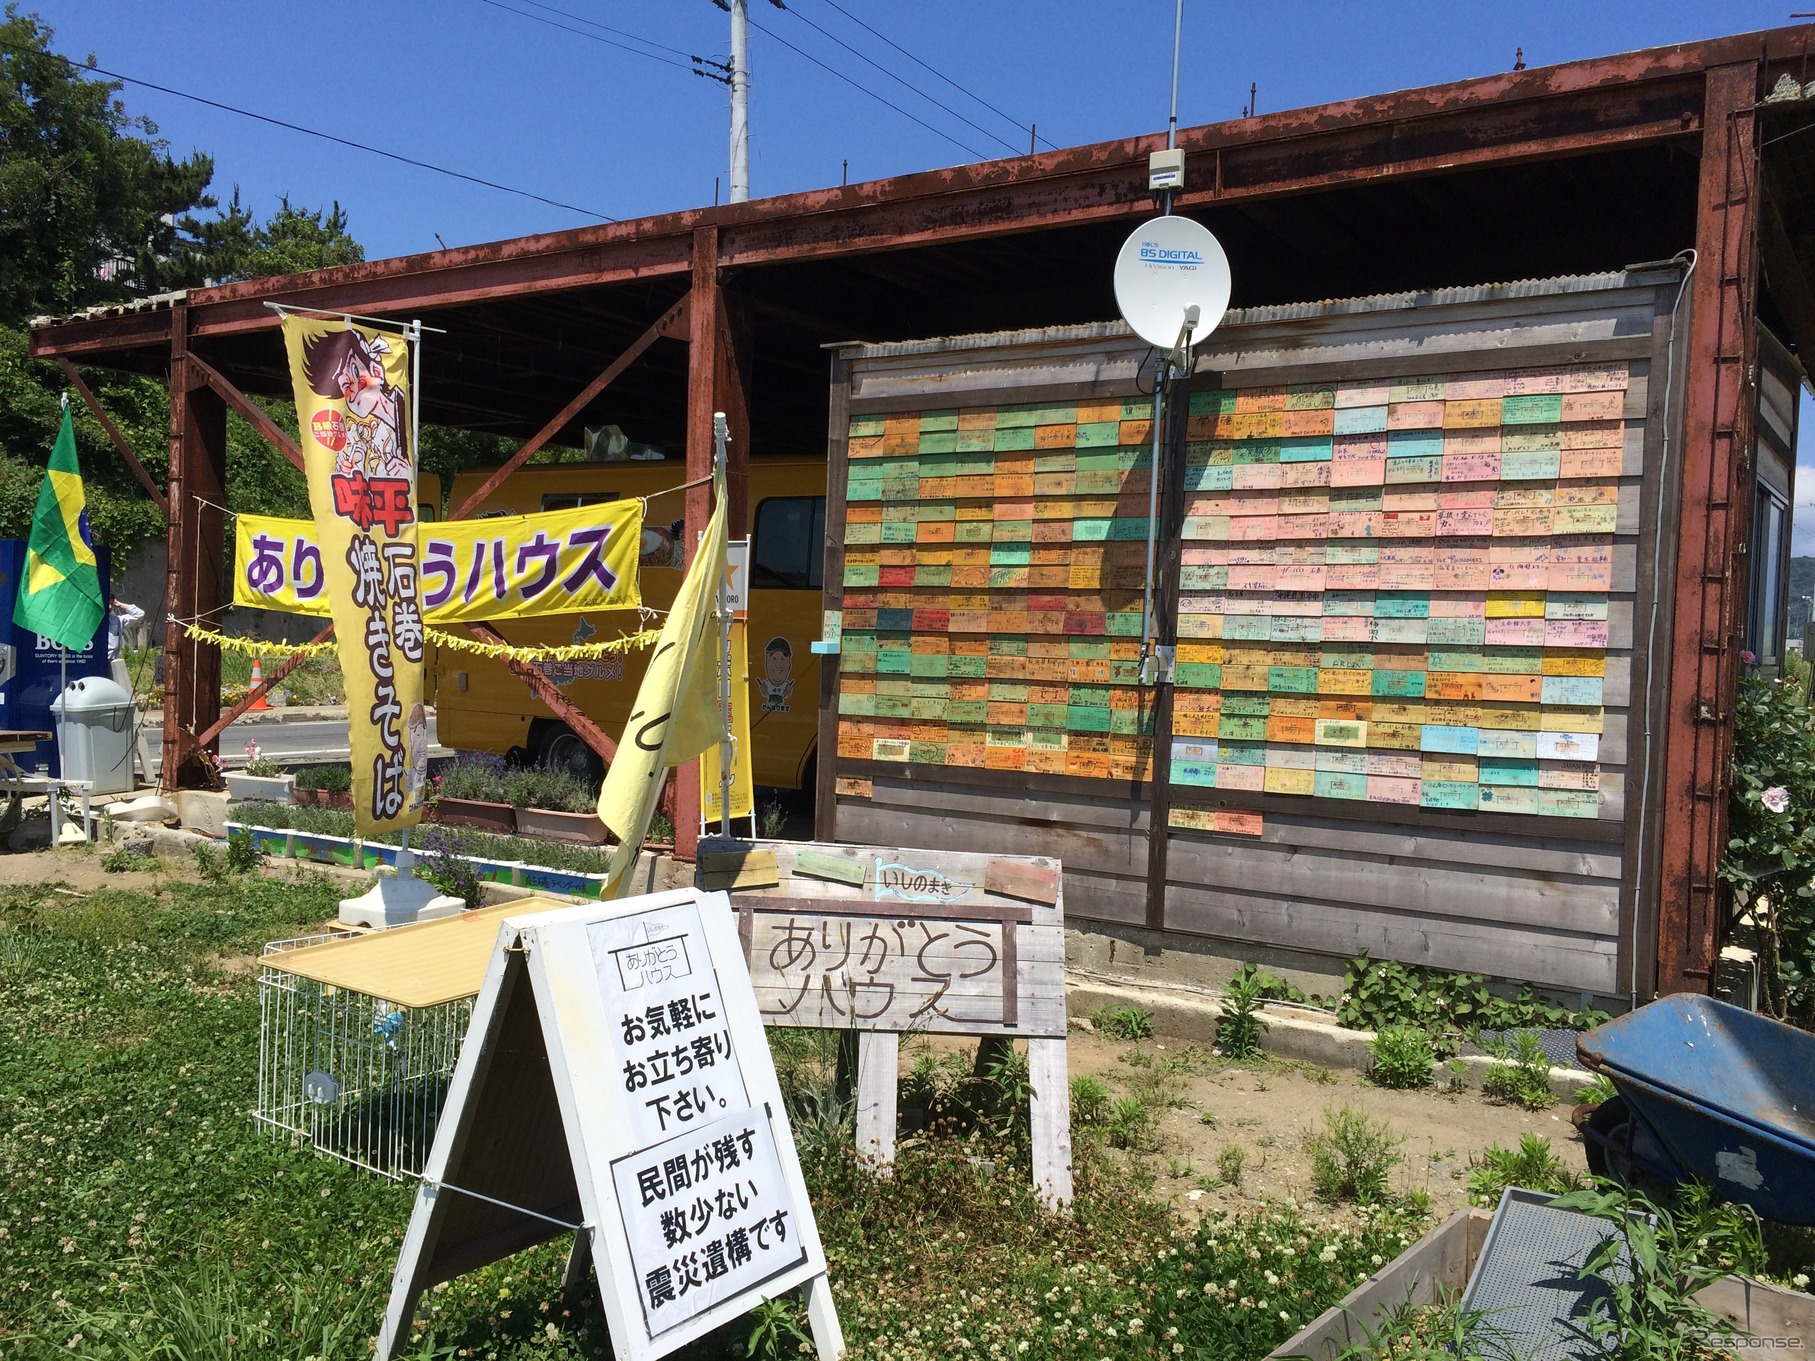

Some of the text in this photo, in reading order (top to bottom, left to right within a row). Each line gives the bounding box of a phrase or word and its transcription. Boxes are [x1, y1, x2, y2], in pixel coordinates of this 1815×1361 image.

[1140, 248, 1203, 260] BS DIGITAL
[332, 471, 415, 537] 味平
[383, 543, 424, 661] 石巻
[346, 534, 405, 819] 焼きそば
[883, 870, 952, 896] いしのまき
[625, 944, 678, 971] ありがとう
[640, 965, 680, 985] ハウス
[769, 917, 997, 979] ありがとう
[620, 992, 716, 1046] お気軽に
[766, 972, 972, 1021] ハウス
[622, 1029, 733, 1093] お立ち寄り
[645, 1084, 727, 1132] 下さい。
[636, 1127, 756, 1209] 民間が残す
[659, 1179, 759, 1250] 数少ない
[644, 1209, 789, 1311] 震災遺構です
